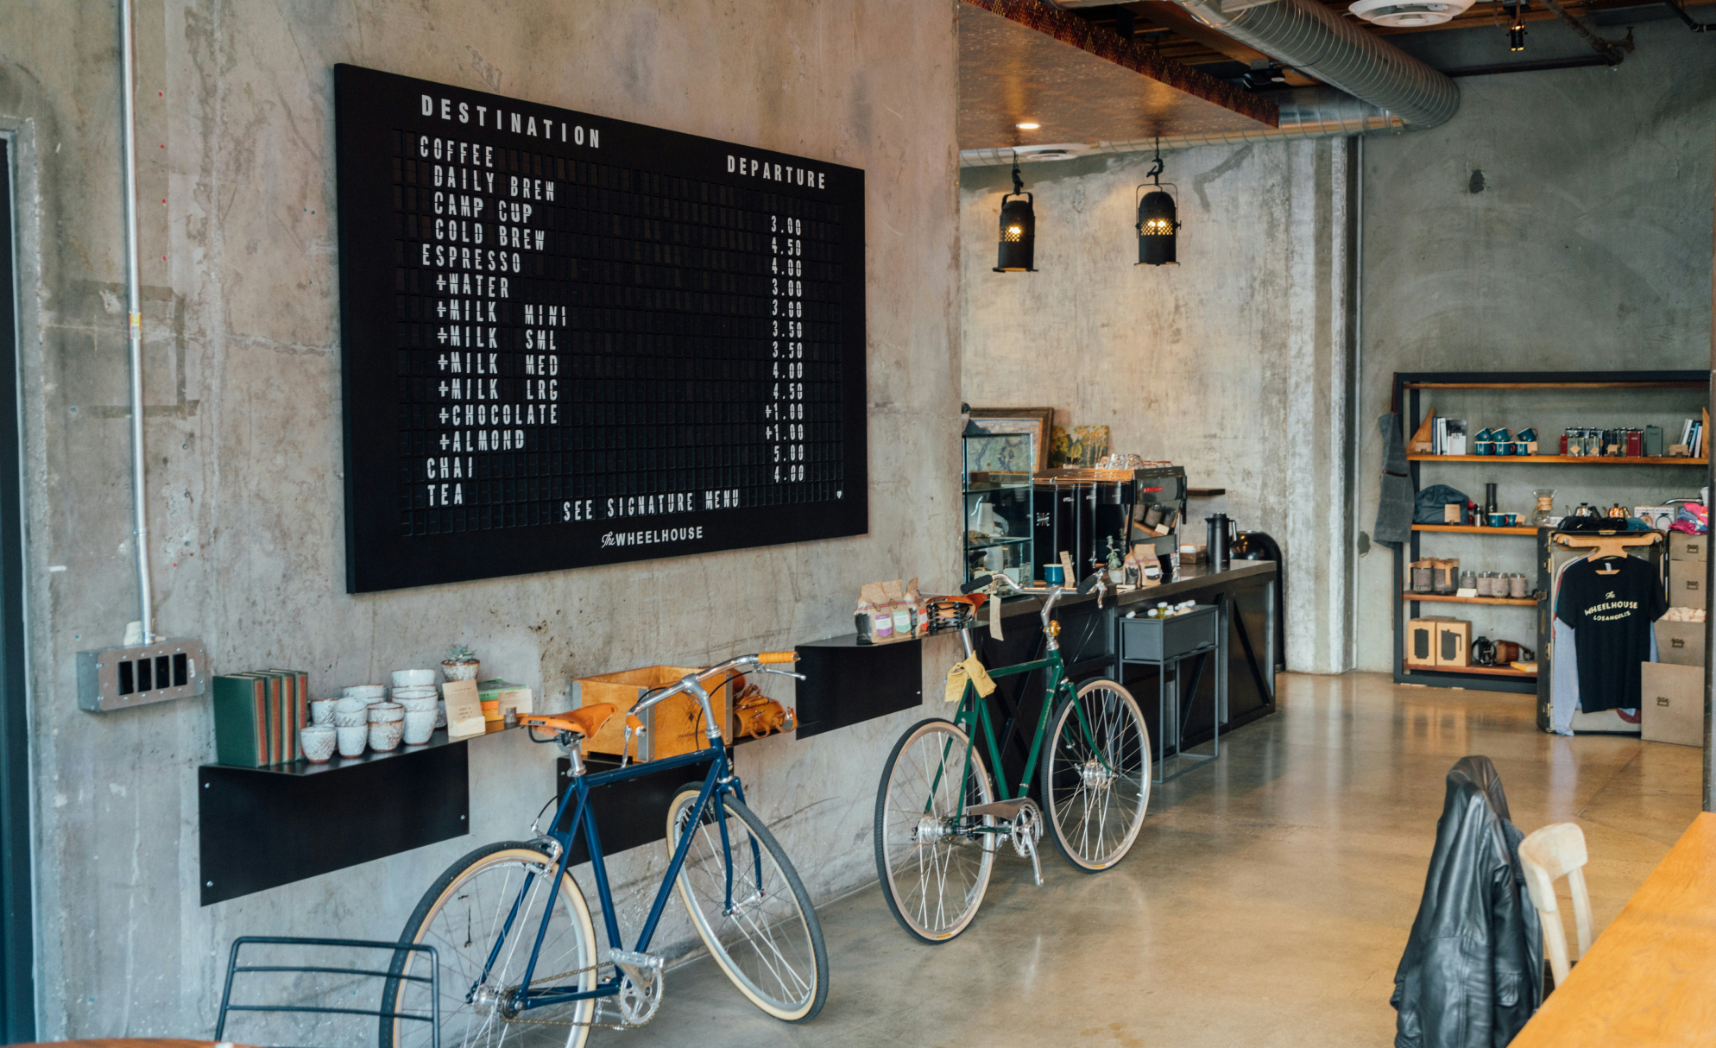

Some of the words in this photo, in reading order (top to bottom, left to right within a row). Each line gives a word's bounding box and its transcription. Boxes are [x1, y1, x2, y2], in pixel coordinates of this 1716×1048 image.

[421, 95, 600, 148] DESTINATION
[420, 135, 493, 168] COFFEE
[727, 155, 825, 189] DEPARTURE
[434, 164, 495, 194] DAILY
[510, 175, 554, 202] BREW
[434, 191, 484, 218] CAMP
[498, 200, 533, 224] CUP
[435, 218, 483, 244] COLD
[498, 225, 545, 251] BREW
[771, 215, 802, 236] 3.00
[771, 236, 801, 257] 4.50
[422, 243, 521, 273] ESPRESSO
[771, 257, 802, 278] 4.00
[771, 277, 802, 298] 3.00
[524, 304, 566, 327] MINI
[772, 298, 802, 318] 3.00
[525, 328, 557, 351] SML
[772, 320, 802, 339] 3.50
[772, 340, 803, 359] 3.50
[525, 354, 558, 376] MED
[772, 361, 803, 380] 4.00
[526, 378, 558, 401] LRG
[773, 382, 803, 401] 4.50
[765, 402, 804, 421] +1.00
[765, 423, 804, 442] +1.00
[773, 444, 804, 463] 5.00
[426, 456, 473, 480] CHAI
[774, 464, 804, 483] 4.00
[427, 482, 463, 507] TEA
[563, 499, 593, 522] SEE
[607, 492, 693, 518] SIGNATURE
[705, 488, 739, 510] MENU
[601, 531, 616, 549] The
[615, 525, 703, 547] WHEELHOUSE
[1605, 590, 1616, 600] The
[1584, 601, 1638, 616] WHEELHOUSE
